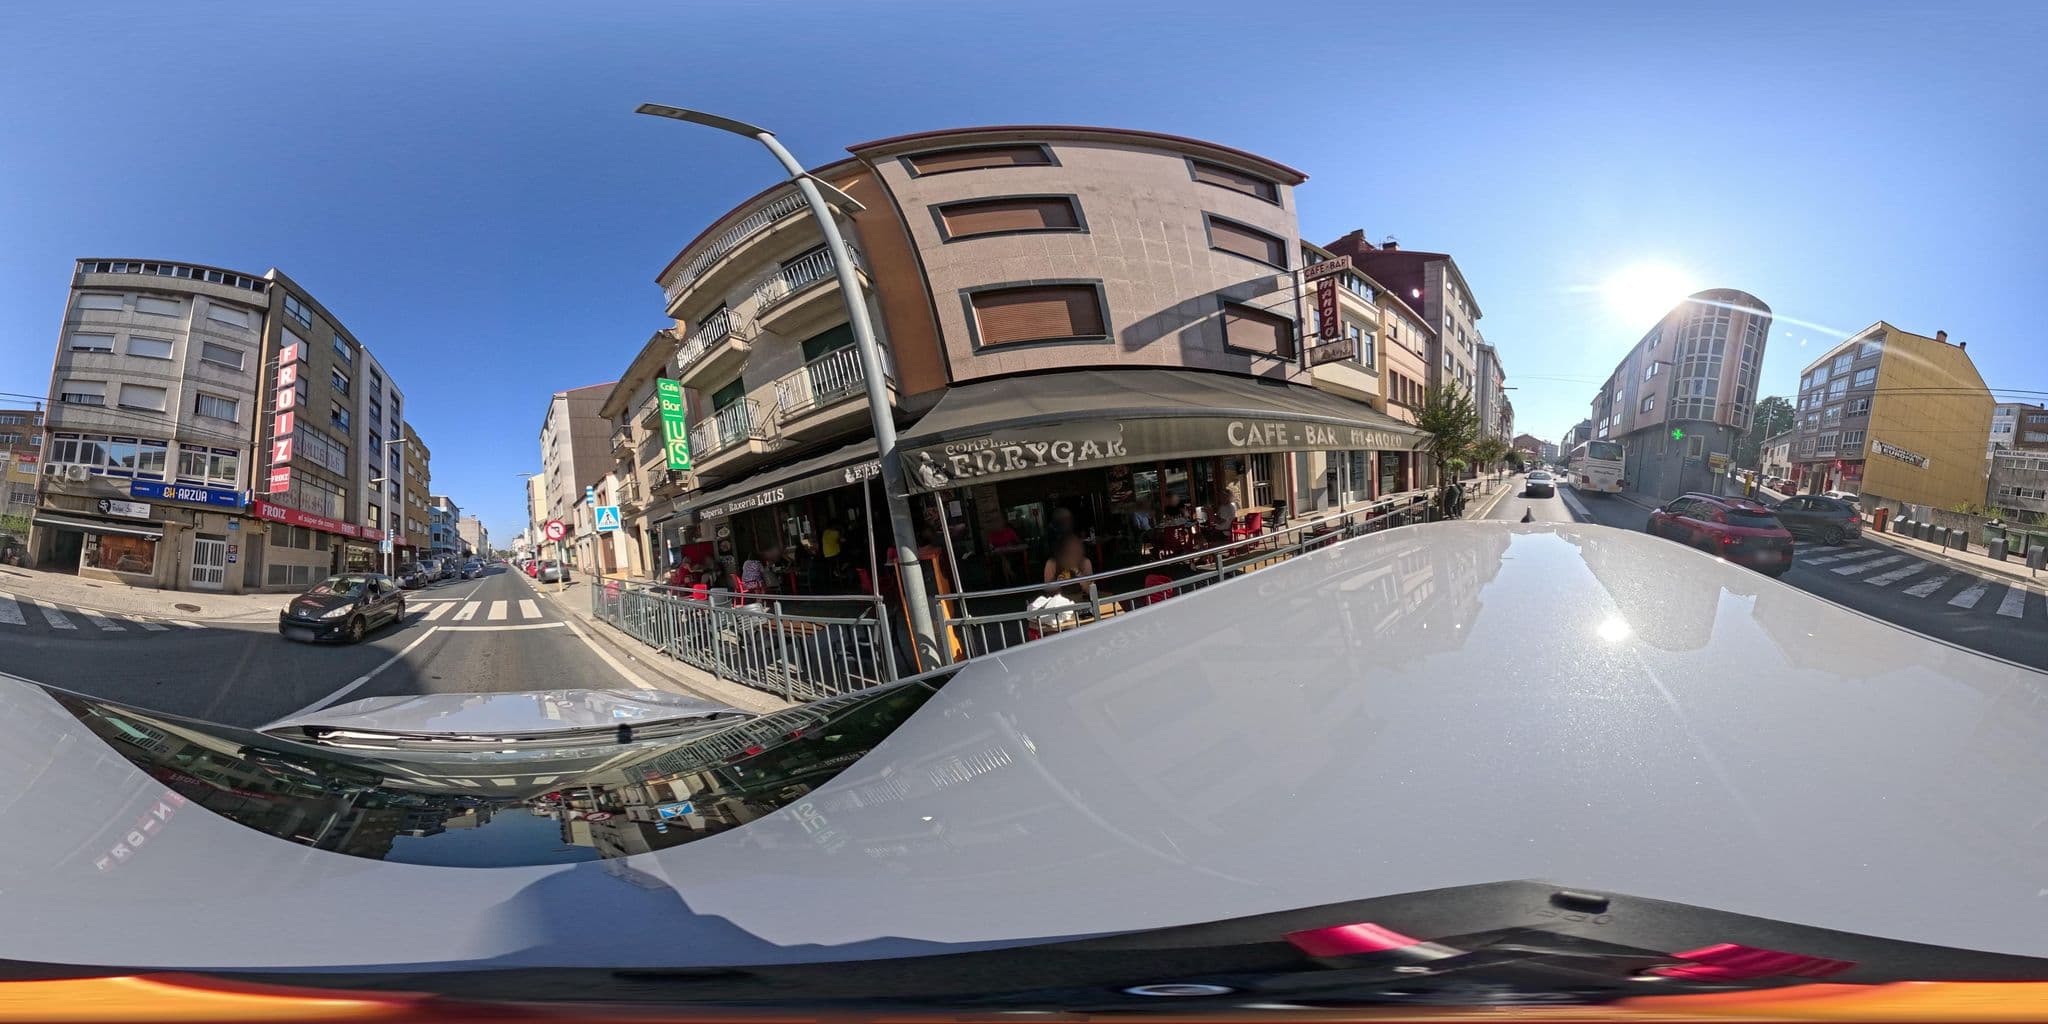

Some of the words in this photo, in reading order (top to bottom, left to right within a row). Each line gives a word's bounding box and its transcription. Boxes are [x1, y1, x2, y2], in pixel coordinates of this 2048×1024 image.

[275, 347, 292, 462] FROIZ
[662, 399, 680, 411] Bar
[1227, 421, 1288, 447] CAFE
[1304, 425, 1339, 446] BAR
[949, 424, 1128, 478] ENRYGAR
[757, 488, 785, 506] LUIS
[262, 503, 287, 519] FROIZ
